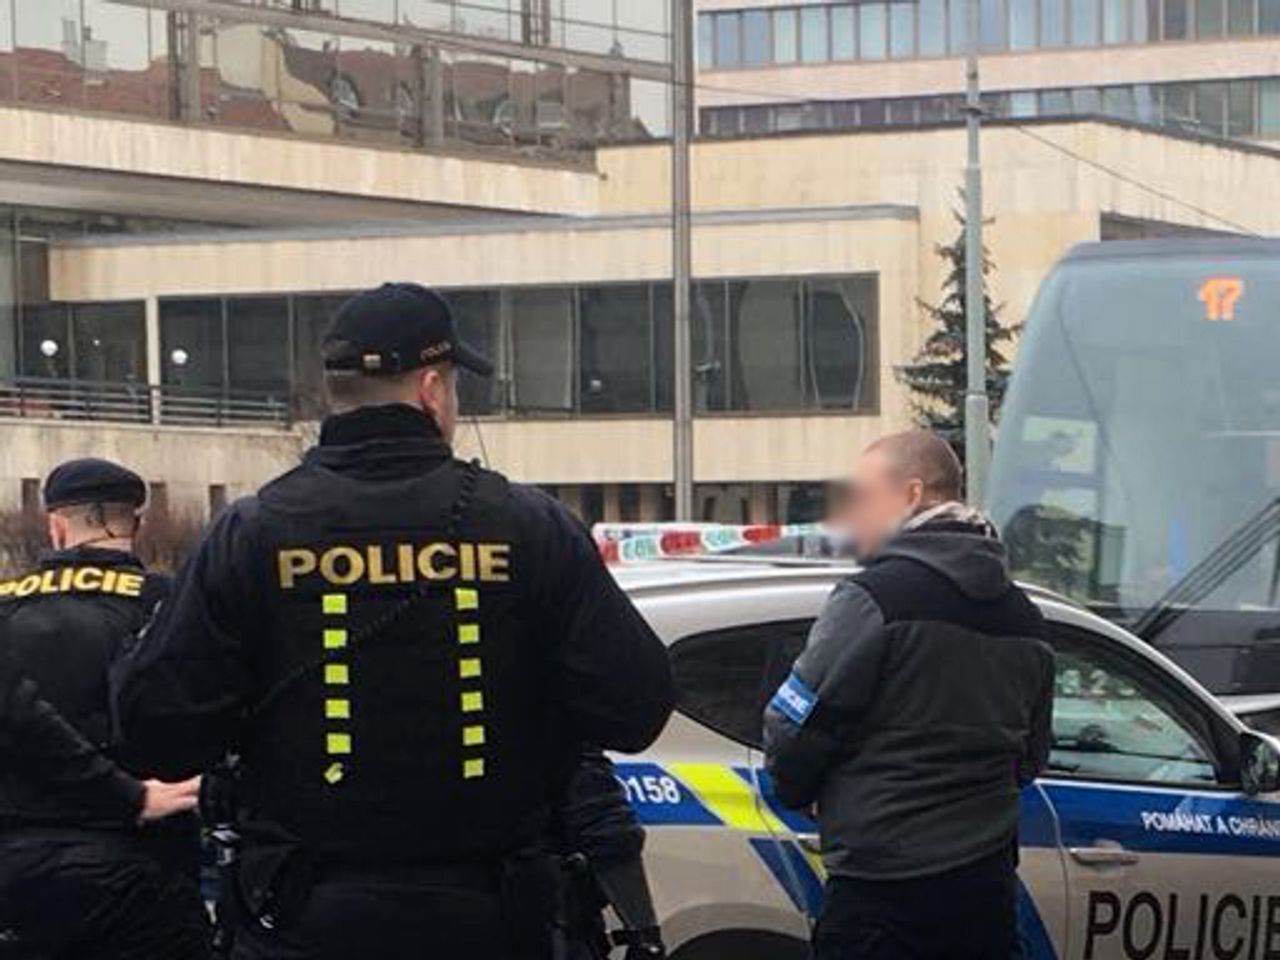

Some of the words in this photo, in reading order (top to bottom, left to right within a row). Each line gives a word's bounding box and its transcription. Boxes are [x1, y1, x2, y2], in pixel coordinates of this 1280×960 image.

[1198, 278, 1243, 320] 17
[278, 542, 511, 589] POLICIE
[0, 566, 145, 597] POLICIE
[627, 775, 680, 804] 158
[1216, 815, 1230, 834] A
